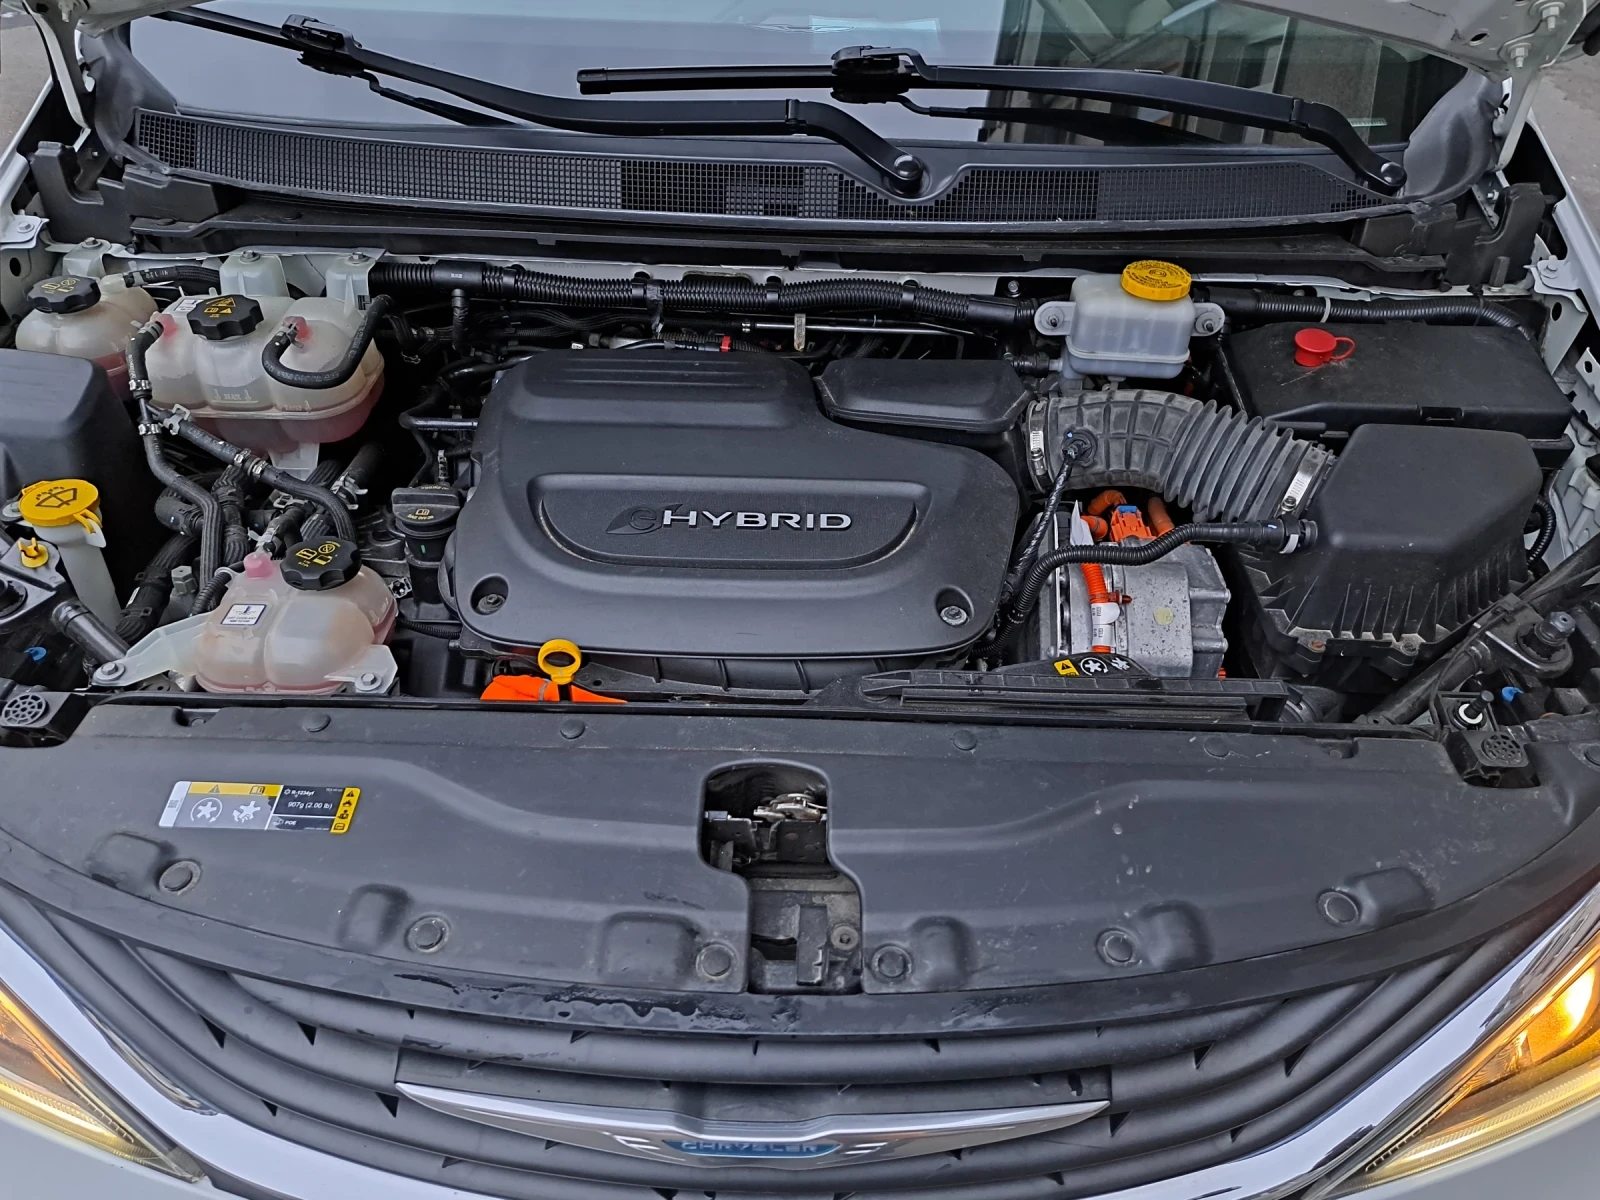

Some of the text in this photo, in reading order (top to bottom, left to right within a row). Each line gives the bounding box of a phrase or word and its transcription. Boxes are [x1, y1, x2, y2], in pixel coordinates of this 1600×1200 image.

[663, 509, 851, 531] HYBRID
[288, 801, 333, 811] 907g (2.00 lb)
[681, 1140, 817, 1152] CHRYSLER
